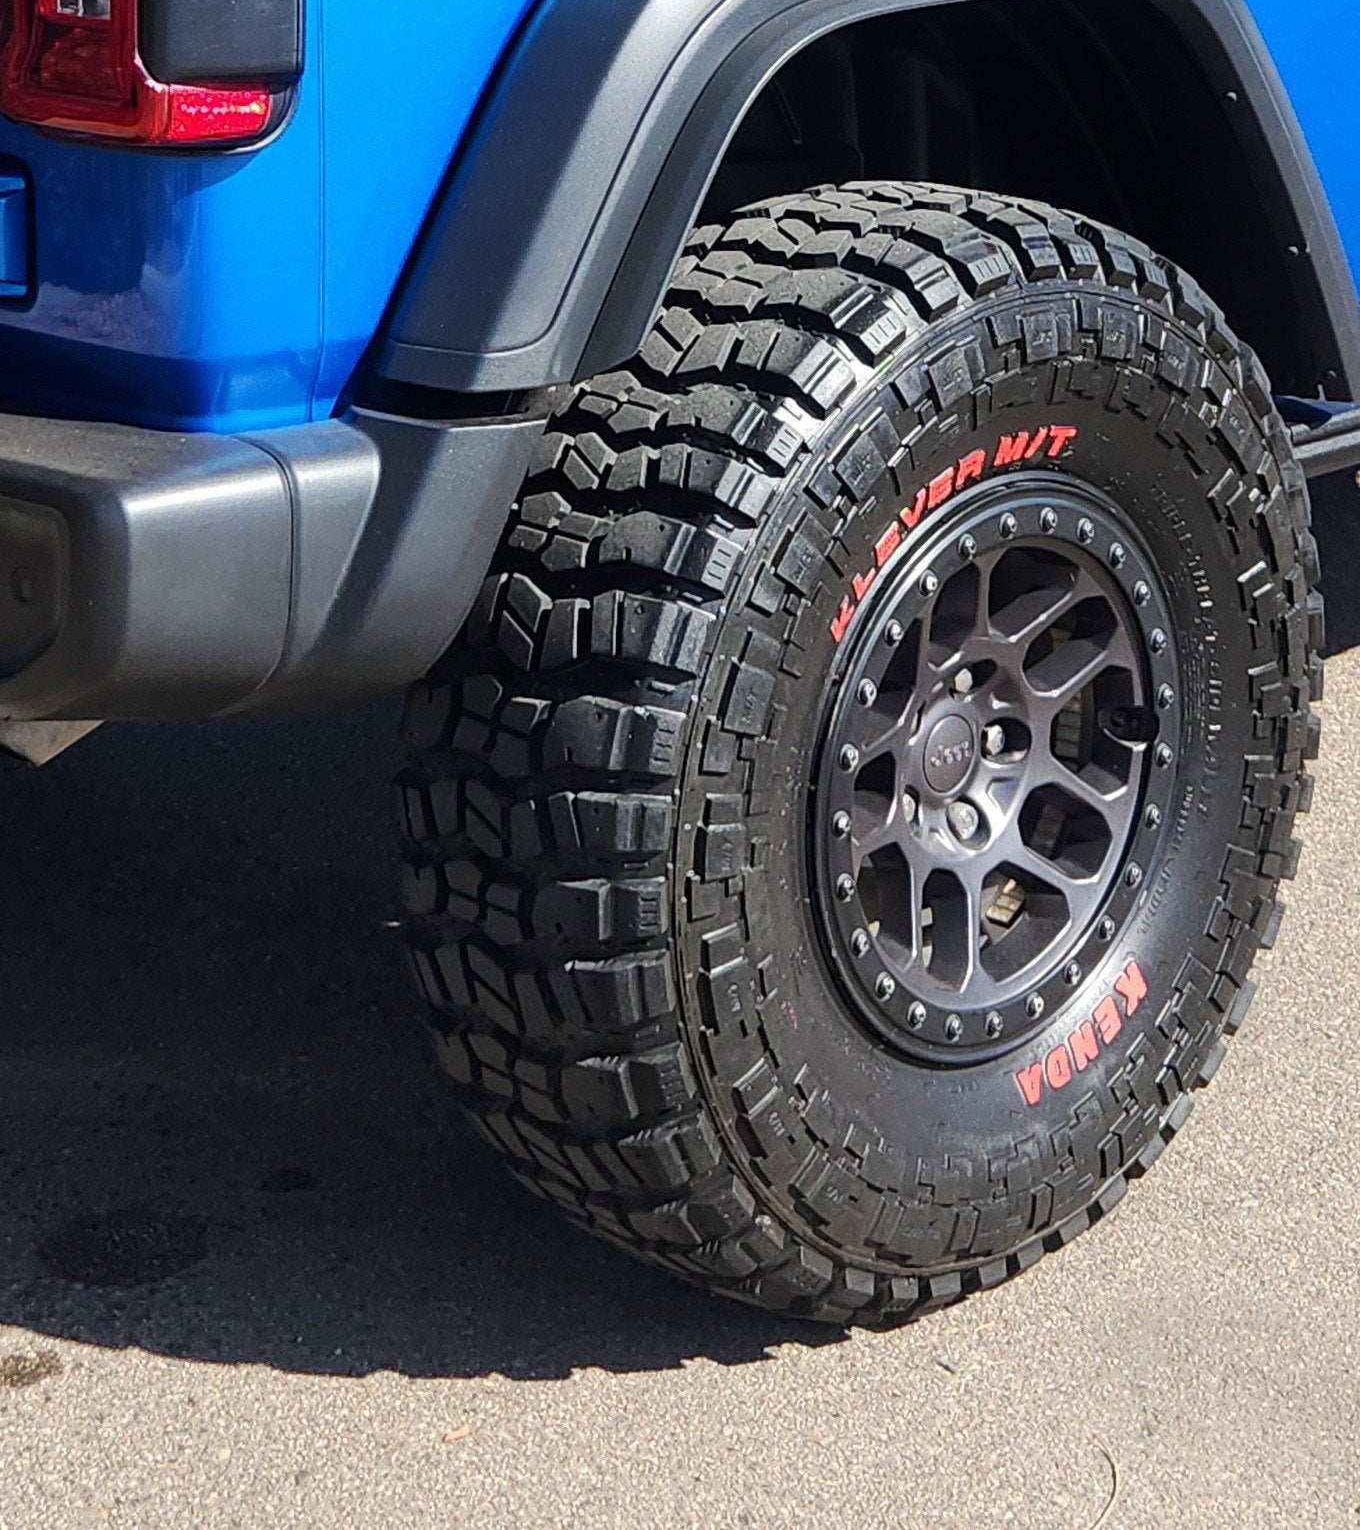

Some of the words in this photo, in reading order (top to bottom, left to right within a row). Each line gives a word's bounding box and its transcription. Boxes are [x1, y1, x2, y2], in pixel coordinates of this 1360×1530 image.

[829, 449, 986, 644] KLEVER
[993, 424, 1078, 468] M/T
[1014, 960, 1148, 1108] KENDA
